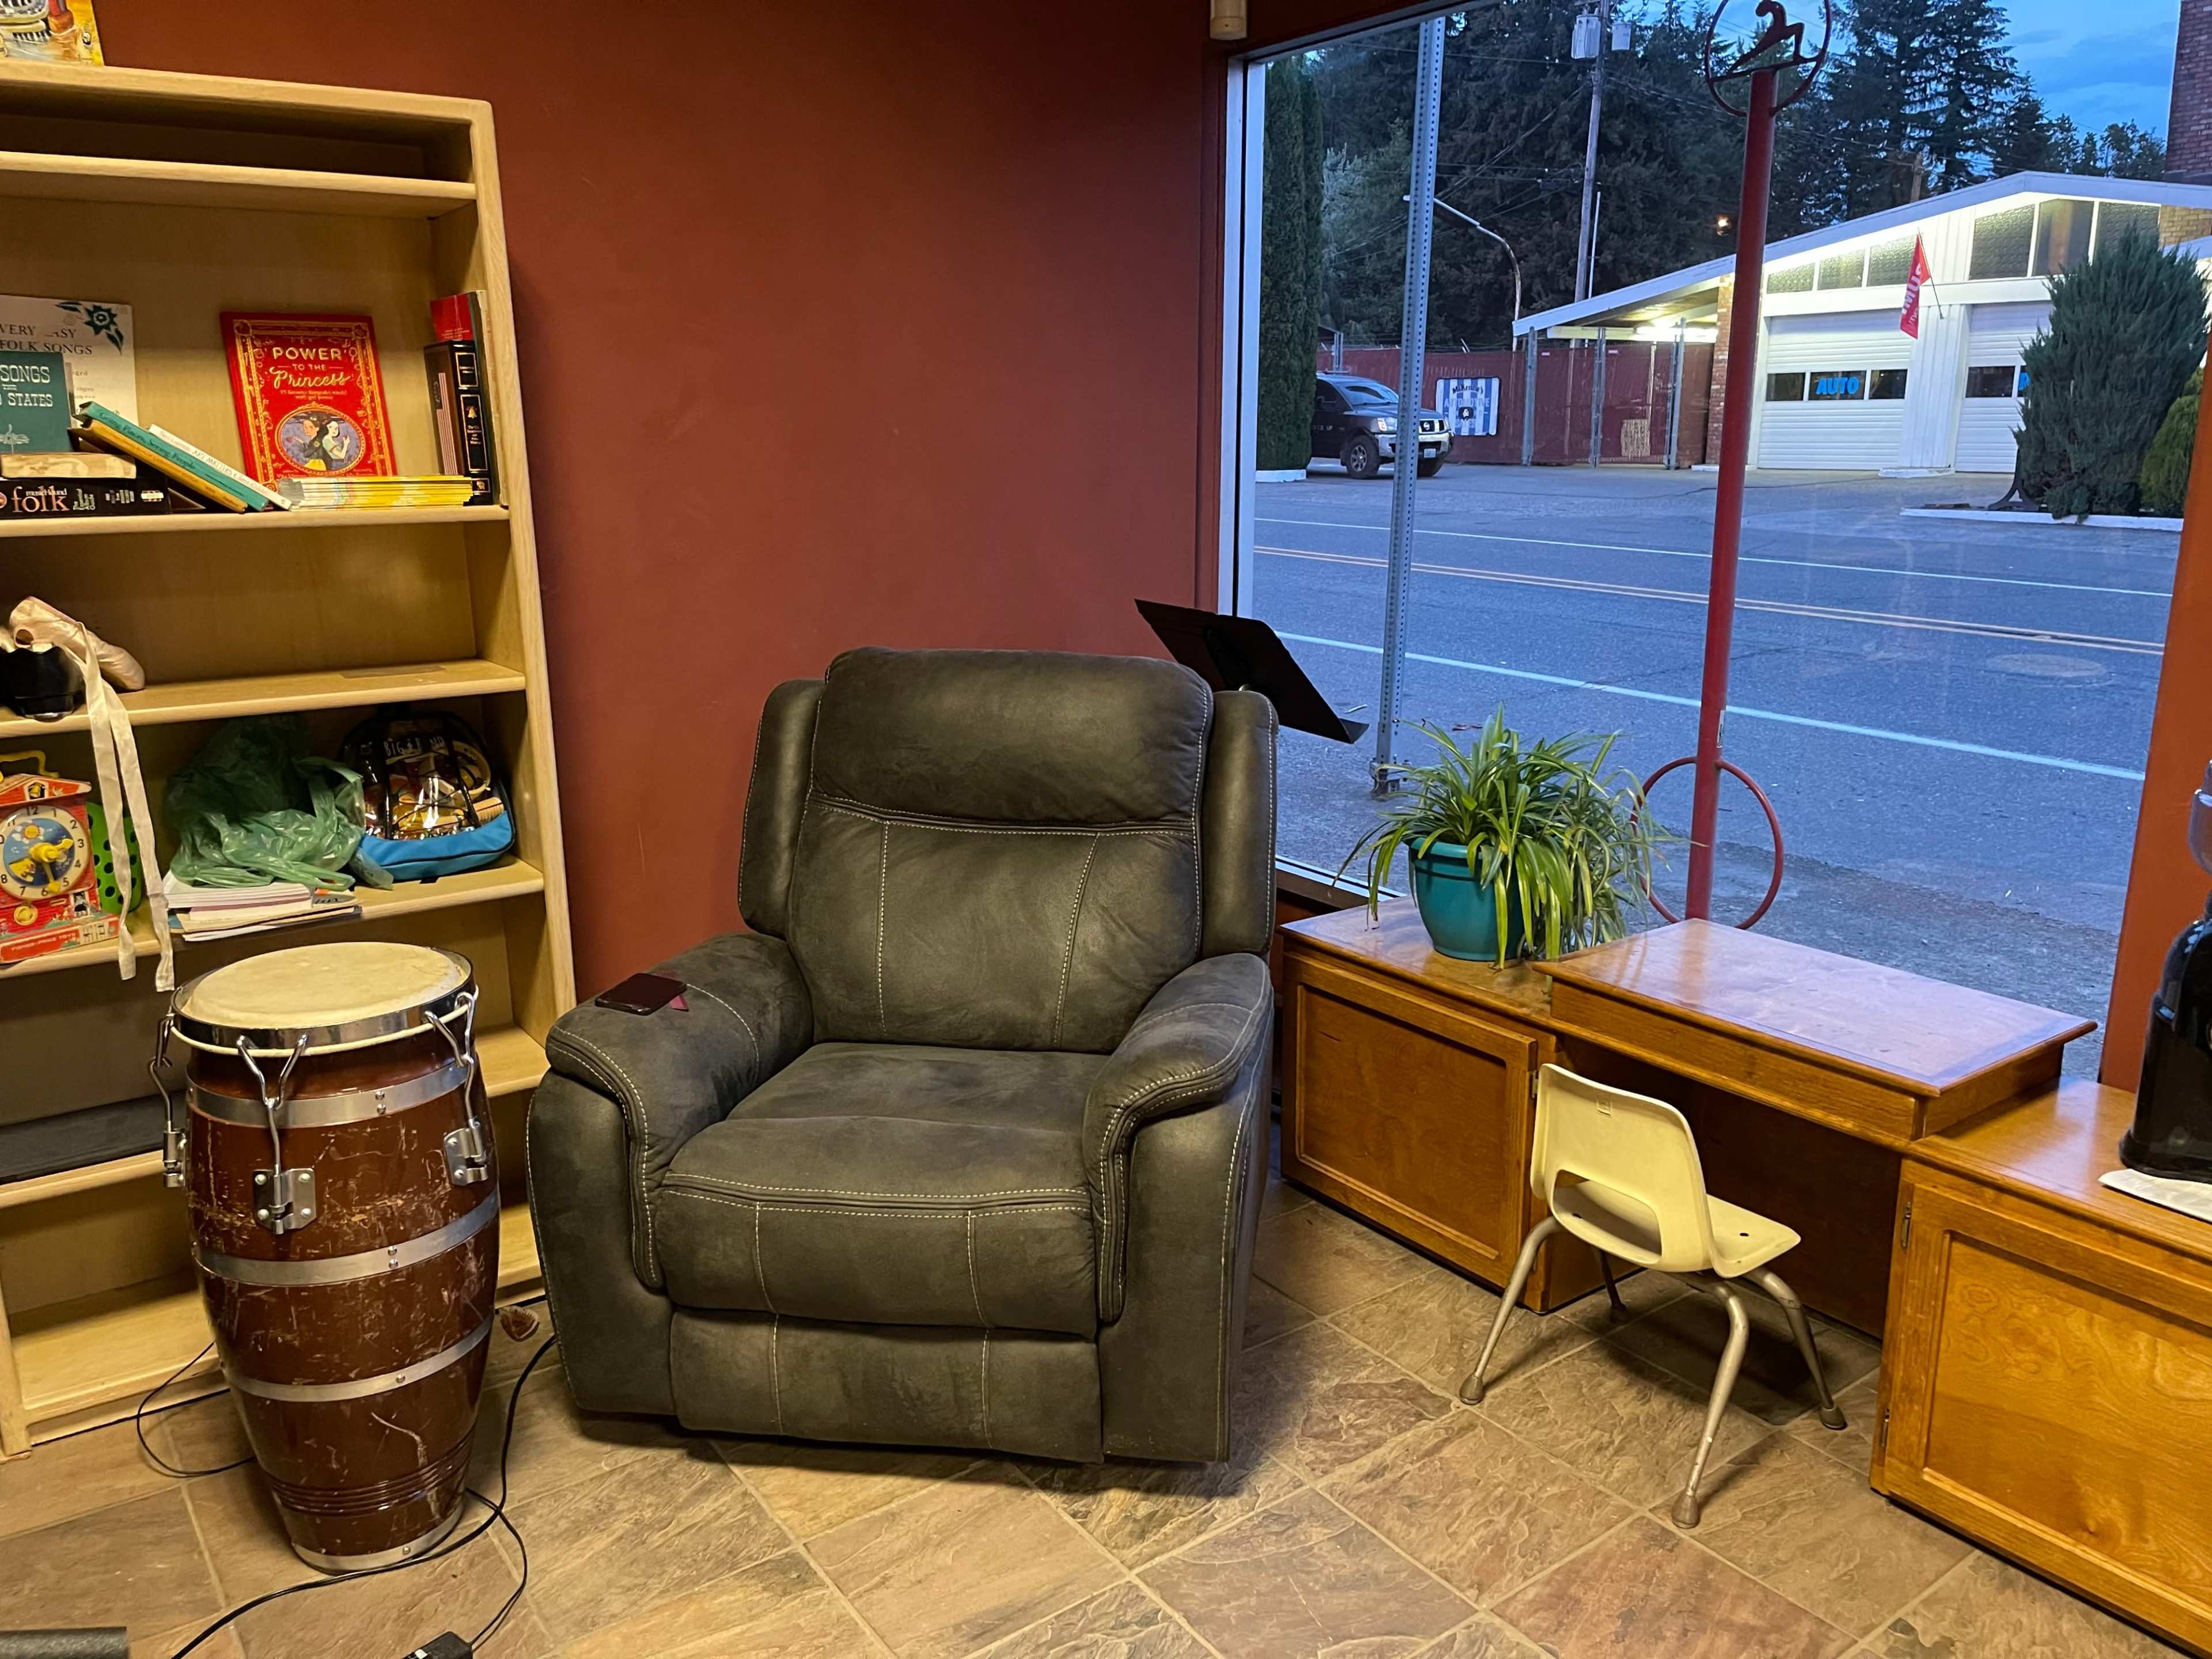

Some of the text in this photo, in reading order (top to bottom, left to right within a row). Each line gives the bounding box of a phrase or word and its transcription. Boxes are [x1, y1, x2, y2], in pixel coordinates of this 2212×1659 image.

[44, 343, 93, 354] SONGS
[272, 347, 342, 360] POWER
[0, 365, 51, 383] SONGS
[269, 366, 351, 389] Princess
[1816, 376, 1860, 395] AUTO
[8, 393, 53, 407] STATES
[12, 486, 70, 513] folk
[26, 806, 38, 815] 12
[70, 820, 78, 830] 2
[77, 839, 85, 848] 3
[75, 859, 81, 868] 4
[1, 874, 7, 883] 8
[63, 877, 70, 887] 5
[20, 886, 26, 896] 7
[41, 887, 49, 896] 6
